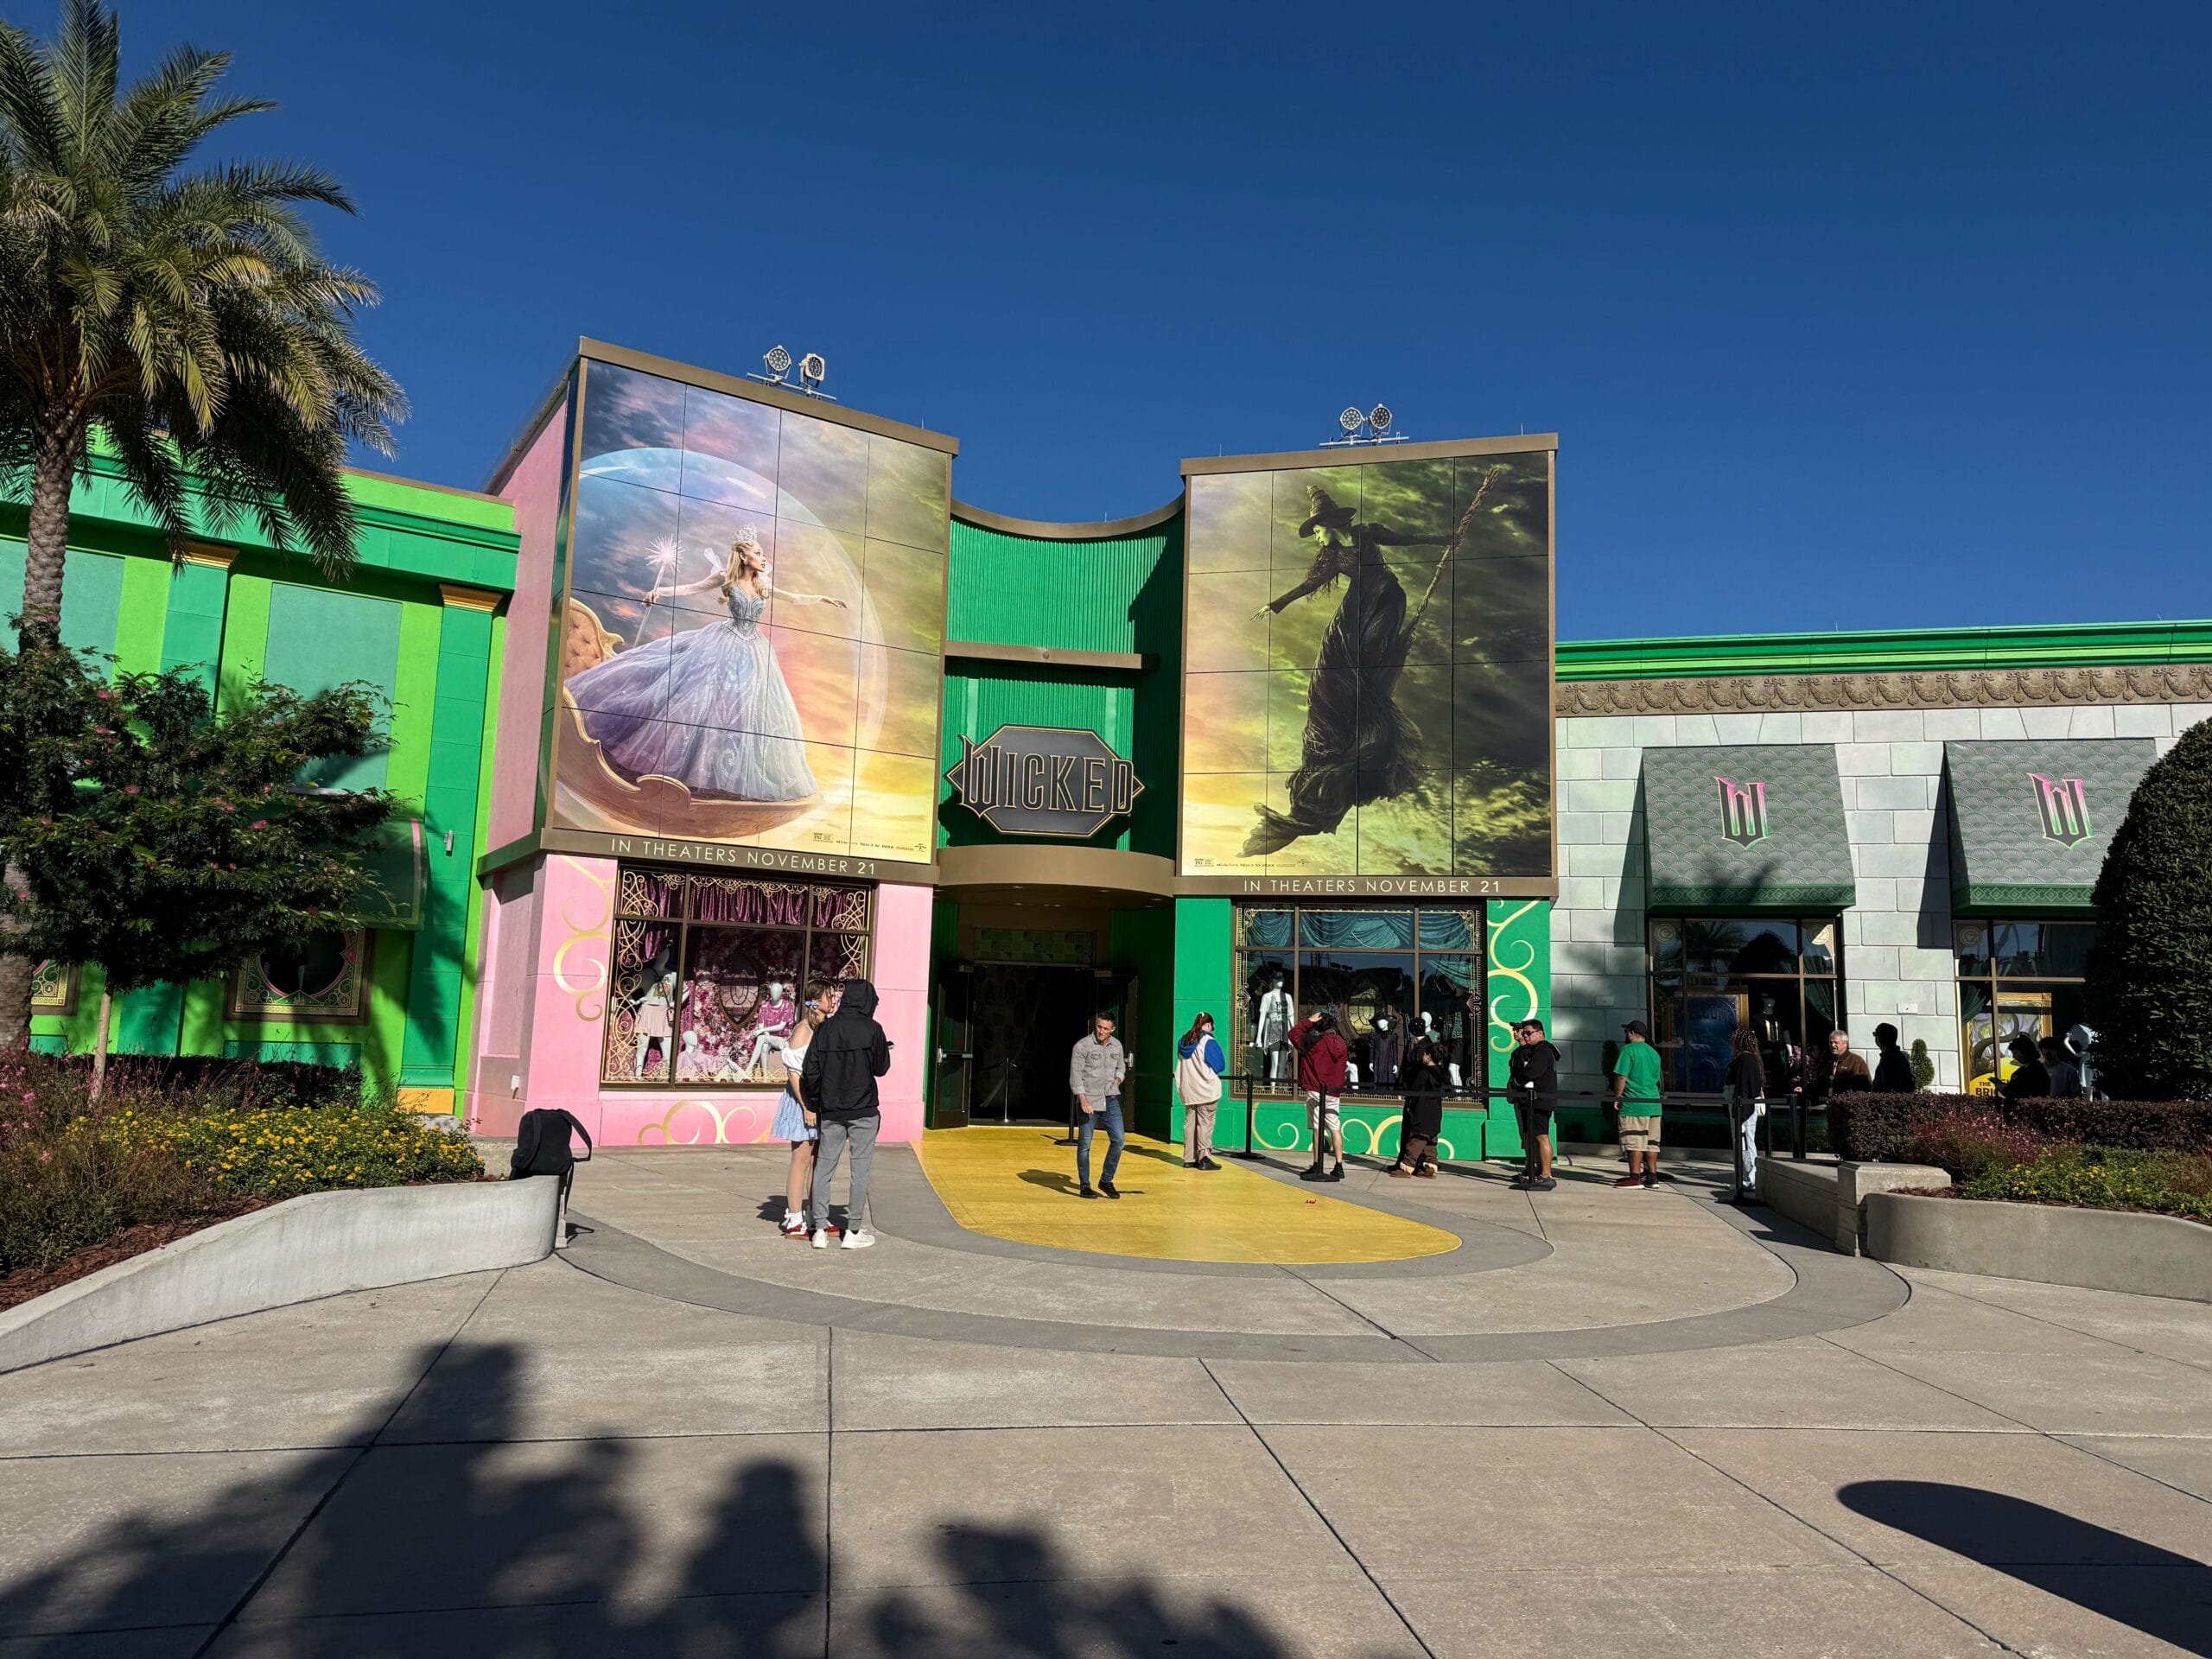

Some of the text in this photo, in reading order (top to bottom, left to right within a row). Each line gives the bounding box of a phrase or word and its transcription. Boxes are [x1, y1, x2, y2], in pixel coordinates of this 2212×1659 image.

[958, 734, 1135, 819] WICKED
[611, 838, 875, 875] IN THEATERS NOVEMBER 21
[1244, 880, 1500, 893] IN THEATERS NOVEMBER 21
